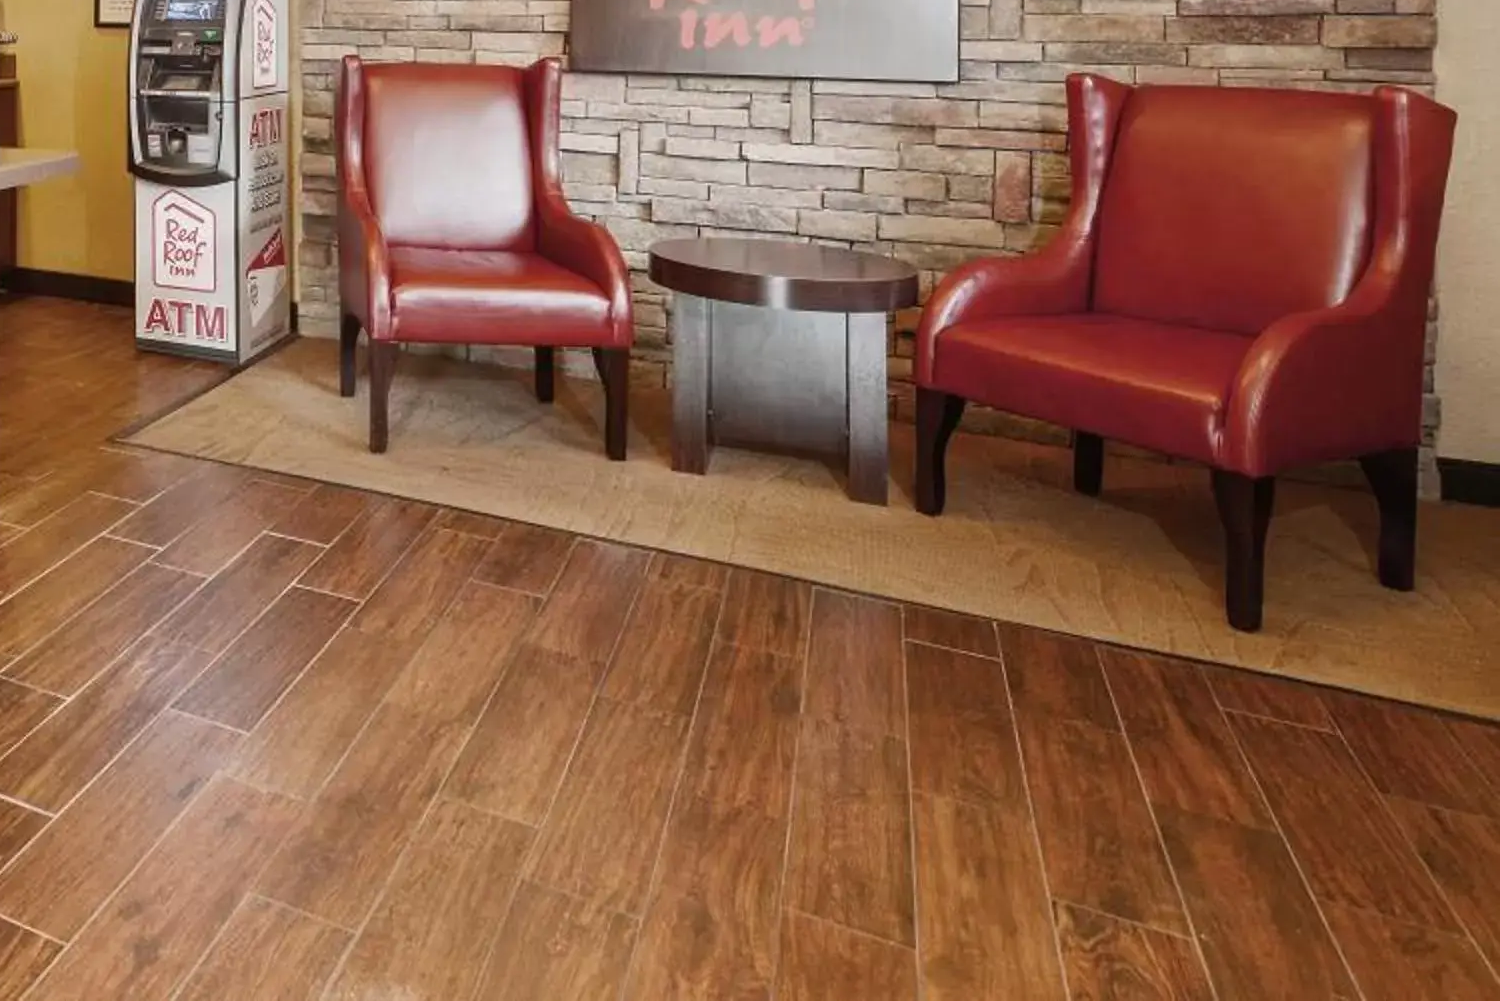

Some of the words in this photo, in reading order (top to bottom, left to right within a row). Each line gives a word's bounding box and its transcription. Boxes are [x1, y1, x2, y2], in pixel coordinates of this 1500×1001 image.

[249, 109, 281, 149] ATM
[165, 218, 198, 244] Red
[164, 240, 207, 267] Roof
[145, 299, 228, 342] ATM
